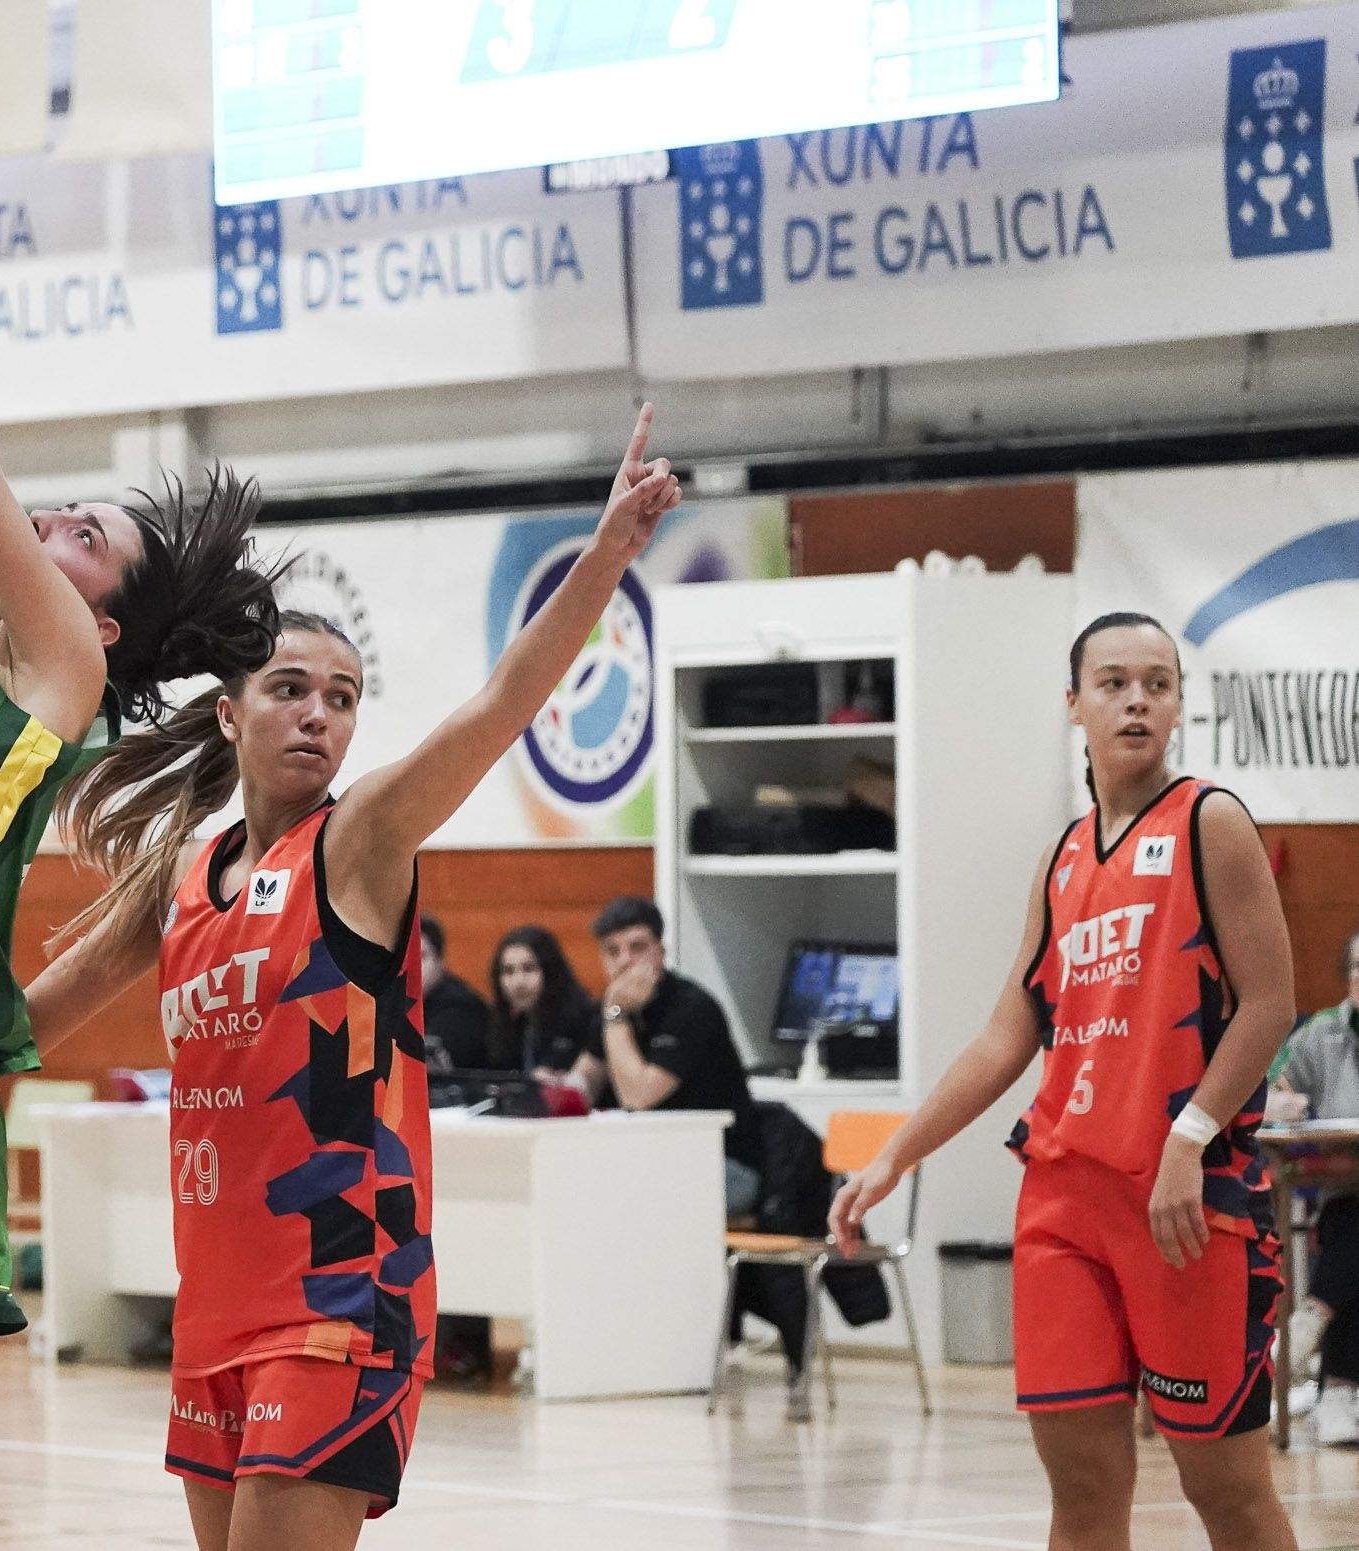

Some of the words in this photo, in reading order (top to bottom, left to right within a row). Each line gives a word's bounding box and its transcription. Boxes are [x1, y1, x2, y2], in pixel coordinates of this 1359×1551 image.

[785, 112, 980, 188] XUNTA
[302, 246, 362, 309] DE
[376, 222, 585, 304] GALICIA
[784, 210, 857, 284] DE
[873, 184, 1116, 276] GALICIA
[185, 1006, 263, 1042] ATARÓ
[1068, 1059, 1095, 1115] 5
[175, 1138, 219, 1206] 29
